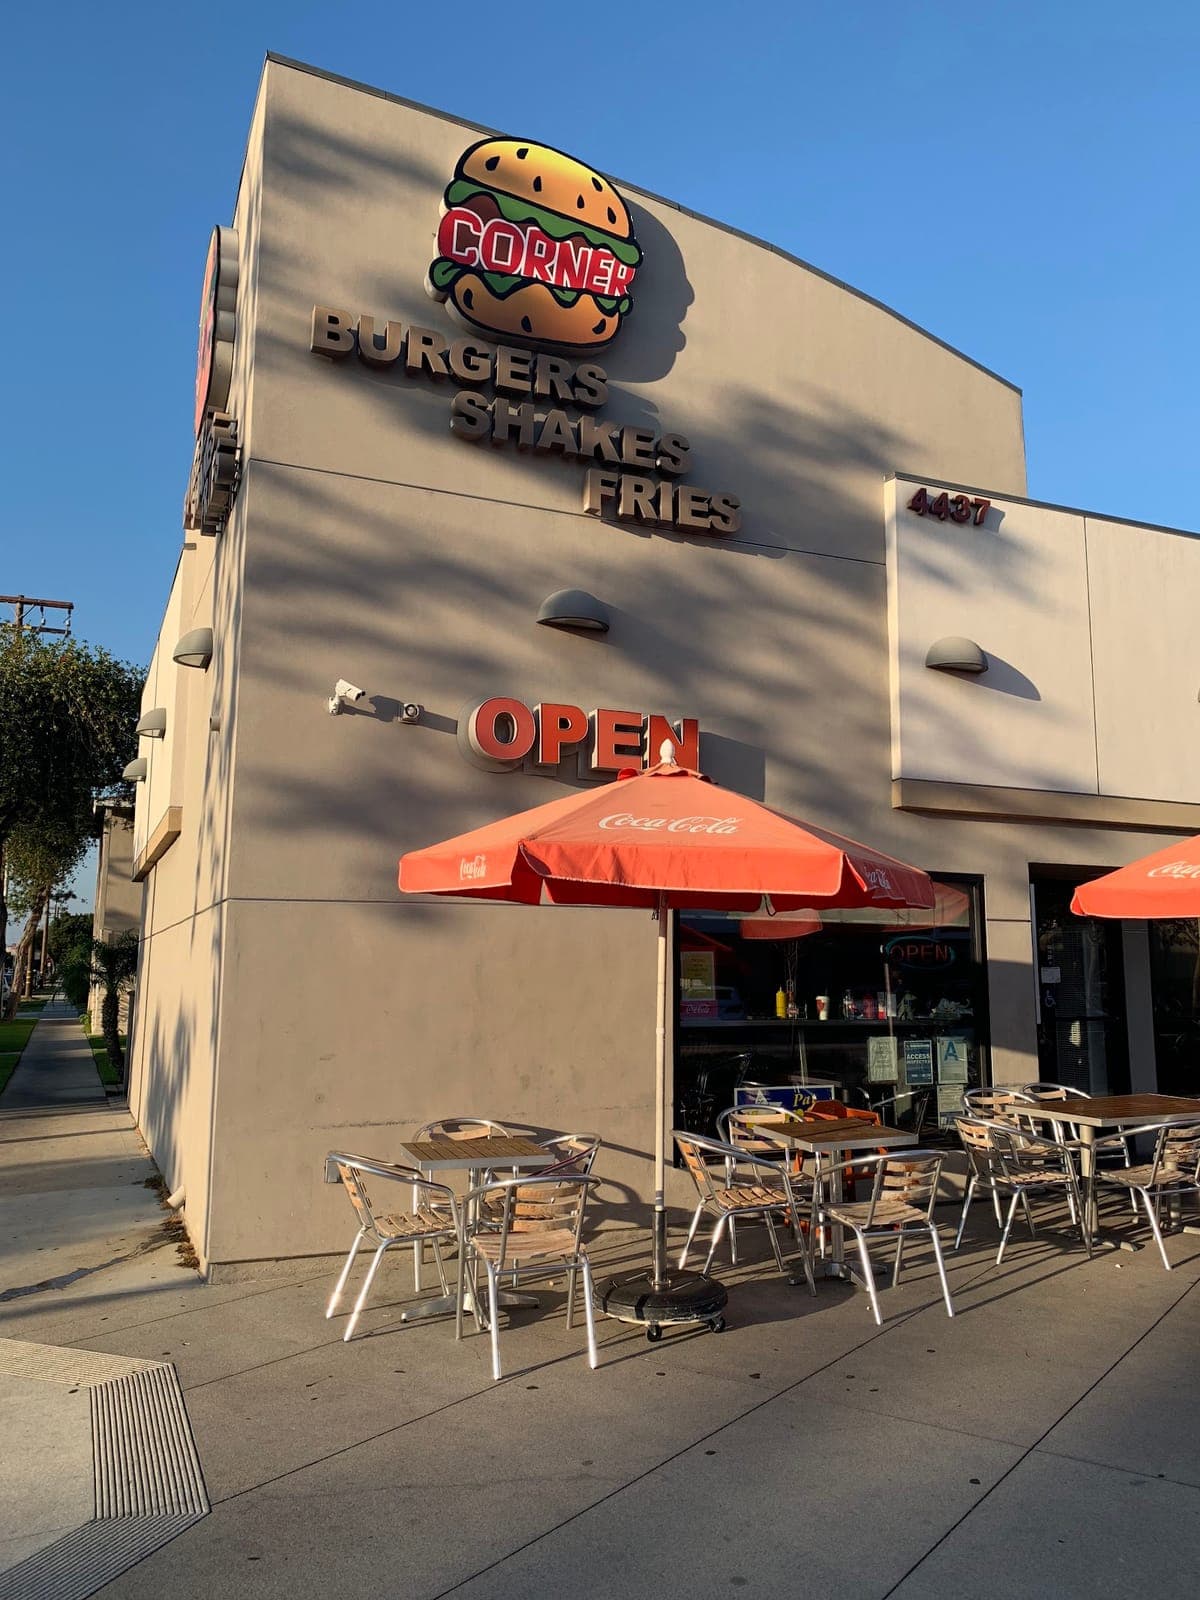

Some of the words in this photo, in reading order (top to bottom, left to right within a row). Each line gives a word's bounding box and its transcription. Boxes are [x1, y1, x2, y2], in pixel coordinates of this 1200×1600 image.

[438, 207, 635, 296] CORNER
[310, 303, 609, 405] BURGERS
[450, 390, 692, 474] SHAKES
[583, 468, 742, 534] FRIES
[908, 488, 991, 526] 4437
[469, 696, 699, 772] OPEN
[890, 943, 949, 961] OPEN
[944, 1040, 959, 1061] A
